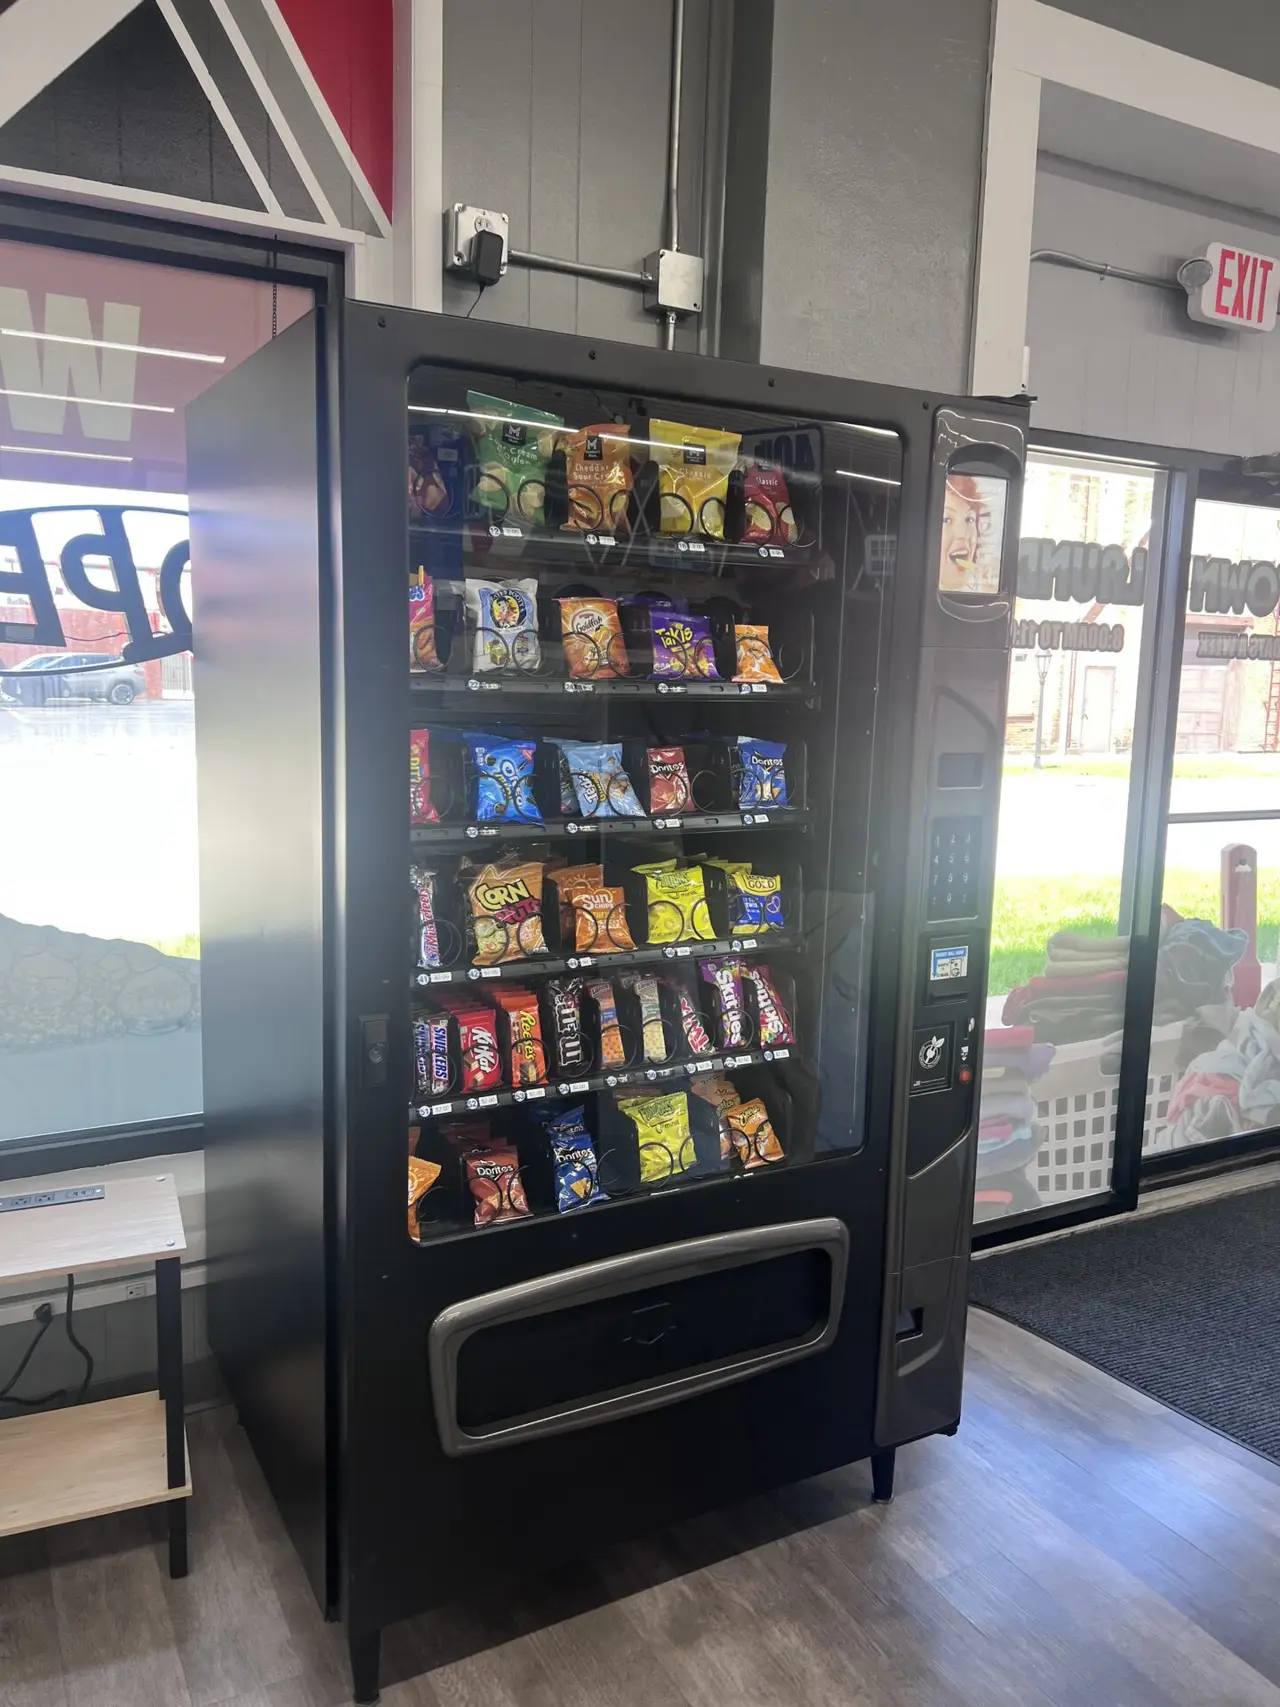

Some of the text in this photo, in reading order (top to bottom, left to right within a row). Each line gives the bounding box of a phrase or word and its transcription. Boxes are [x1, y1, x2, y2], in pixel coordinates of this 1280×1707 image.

[1215, 248, 1274, 324] EXIT
[490, 527, 500, 536] 12
[575, 616, 603, 633] Goldfish
[655, 626, 693, 649] Takis
[469, 680, 479, 689] 22
[751, 755, 783, 767] Doritos
[650, 761, 684, 775] Doritos
[467, 827, 478, 836] 32
[568, 823, 577, 832] 34
[748, 880, 775, 890] GOLD
[476, 879, 531, 910] CORN
[582, 892, 613, 910] Sun
[470, 970, 479, 978] 42
[716, 969, 742, 1045] Skittles
[749, 970, 784, 1034] Skittles
[520, 1010, 537, 1061] Reese's
[433, 1026, 447, 1080] SNICKERS
[648, 1070, 657, 1078] 56
[608, 1076, 617, 1085] 55
[559, 1084, 569, 1093] 54
[515, 1091, 525, 1100] 53
[467, 1099, 478, 1108] 52
[420, 1107, 430, 1116] 51
[556, 1147, 593, 1164] Doritos
[476, 1164, 514, 1177] Doritos
